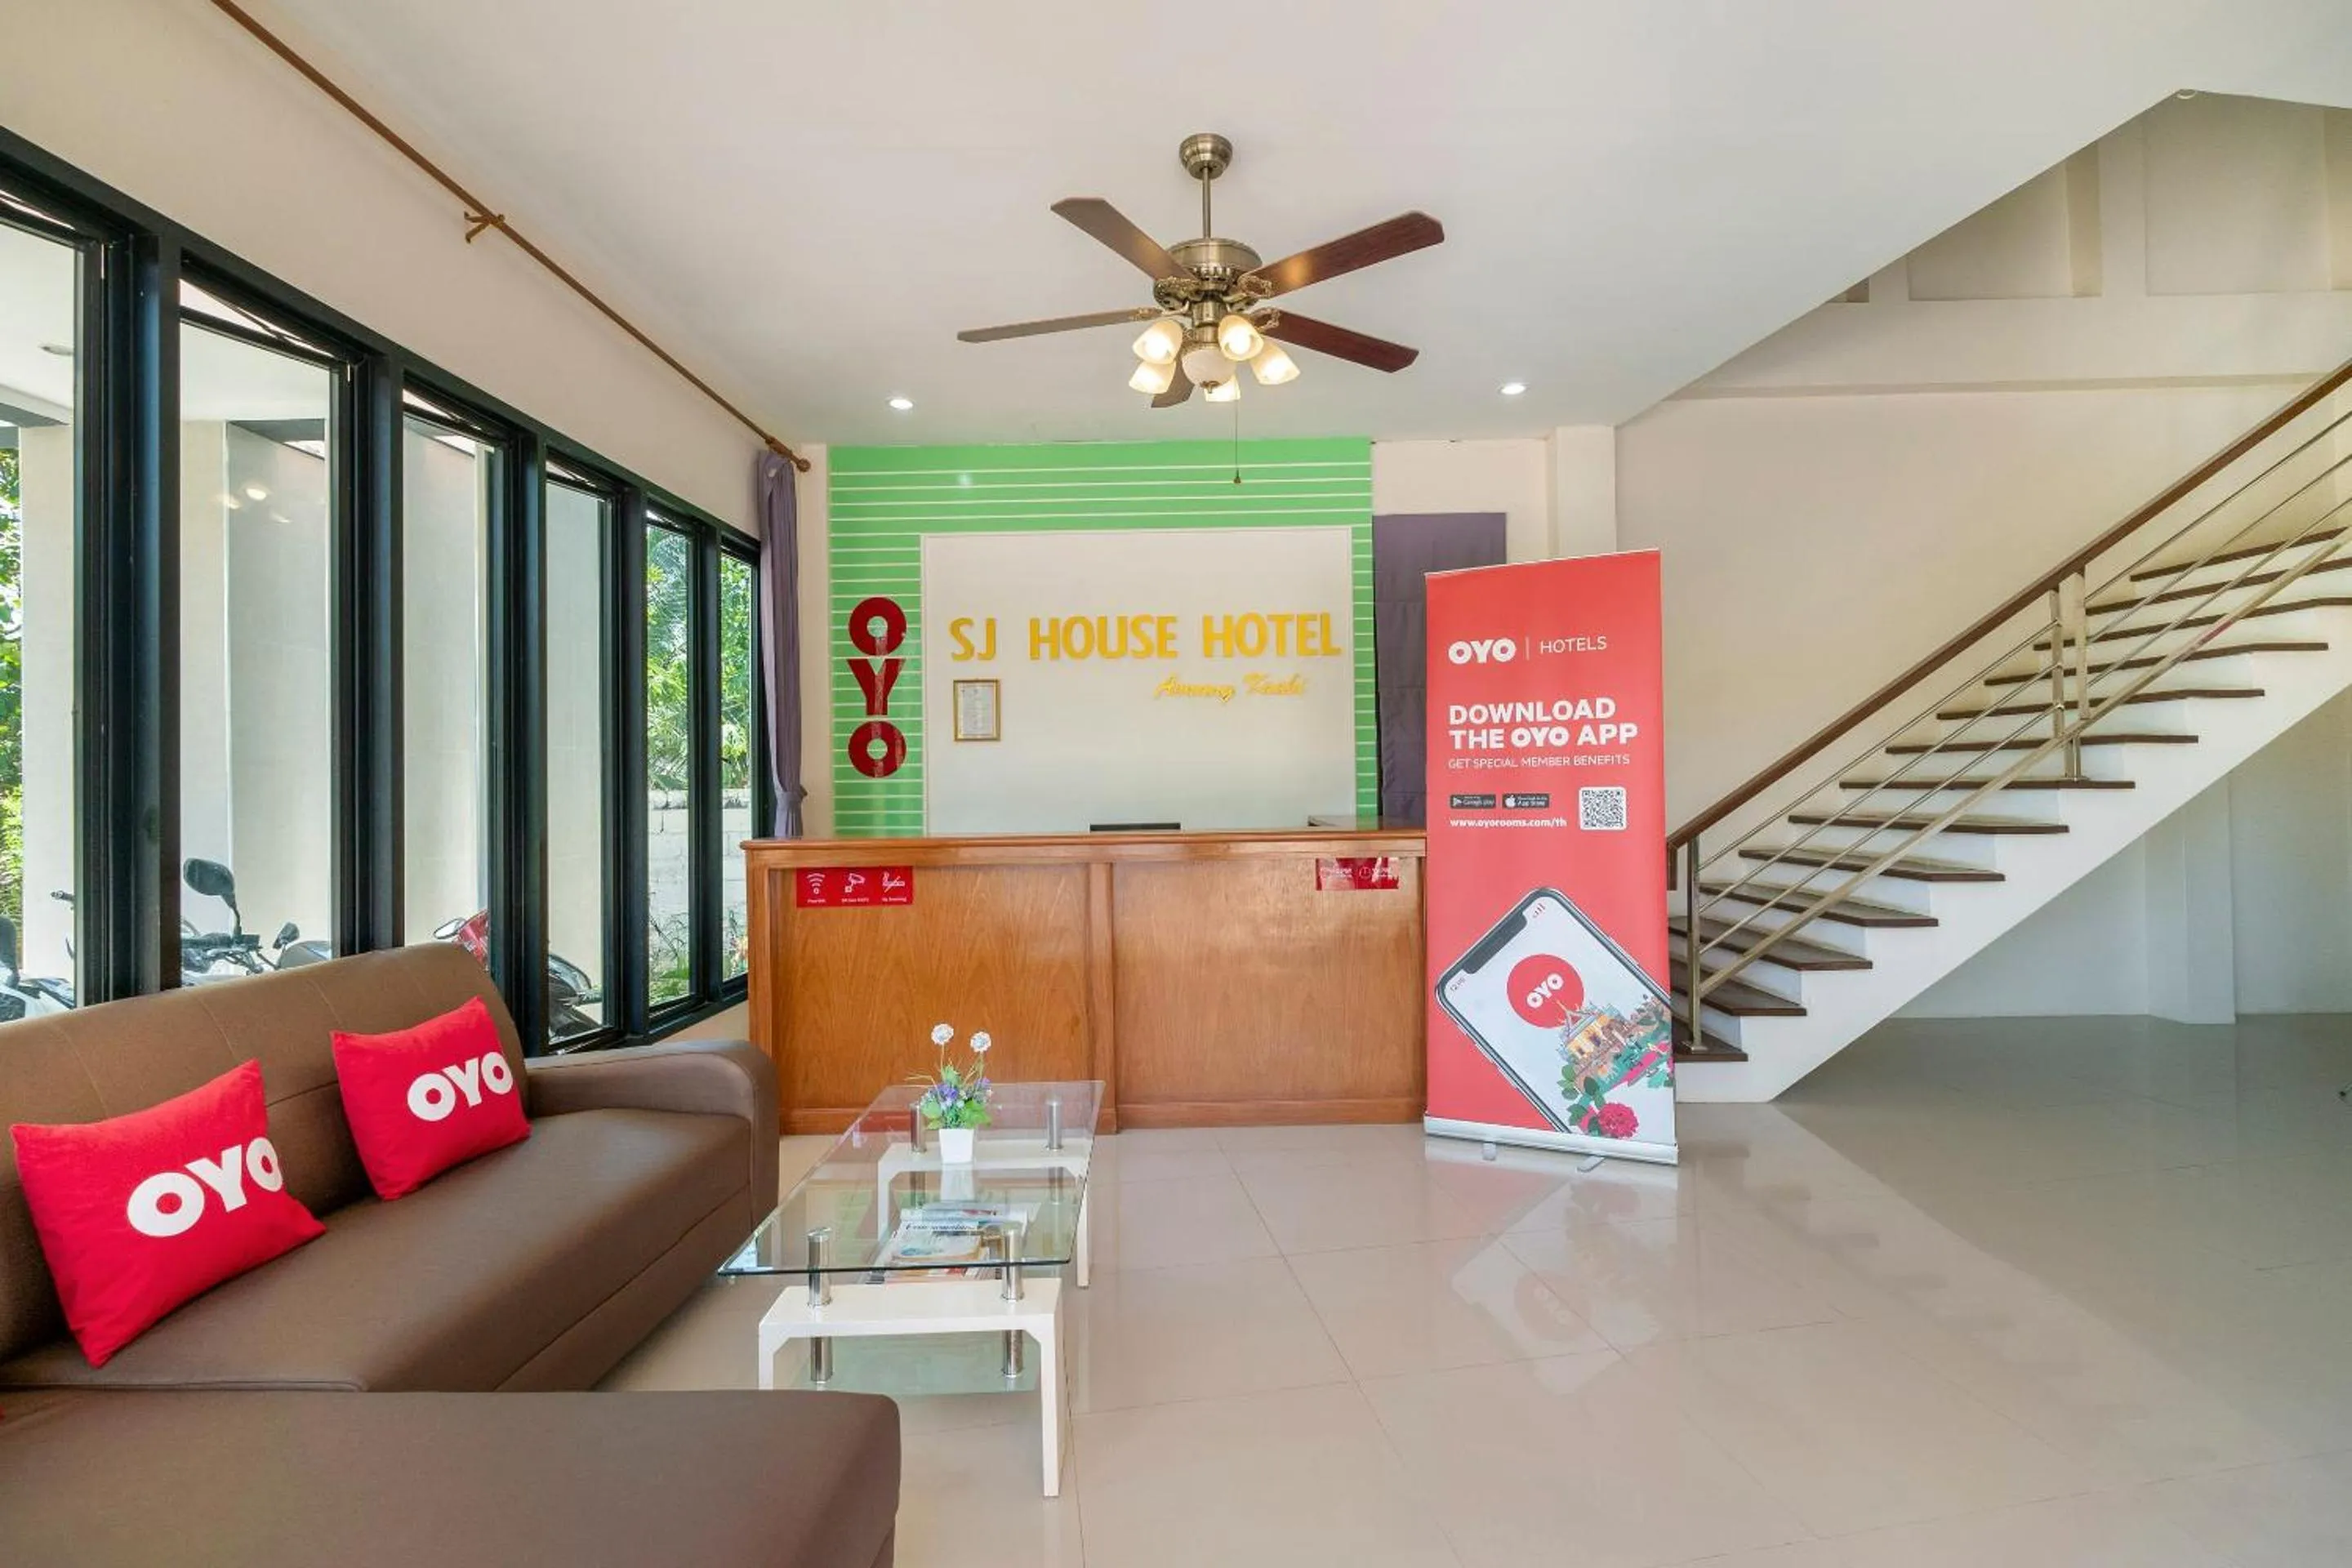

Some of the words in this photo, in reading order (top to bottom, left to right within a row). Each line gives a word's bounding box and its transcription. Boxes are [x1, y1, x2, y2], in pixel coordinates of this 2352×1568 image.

[948, 617, 996, 662] SJ
[1029, 615, 1178, 660] HOUSE
[1202, 612, 1342, 657] HOTEL
[1448, 638, 1517, 665] OYO
[1540, 635, 1607, 654] HOTELS
[847, 596, 907, 778] OYO
[1449, 697, 1616, 725] DOWNLOAD
[1448, 728, 1504, 751] THE
[1510, 726, 1570, 748] OYO
[1576, 723, 1638, 746] APP
[1448, 758, 1471, 770] GET
[1472, 757, 1518, 769] SPECIAL
[1521, 755, 1570, 768] MEMBER
[1573, 754, 1630, 767] BENEFITS
[1450, 817, 1567, 828] www.oyorooms.com/th
[1526, 973, 1565, 1009] OYO
[407, 1051, 514, 1122] OYO
[127, 1137, 284, 1237] OYO
